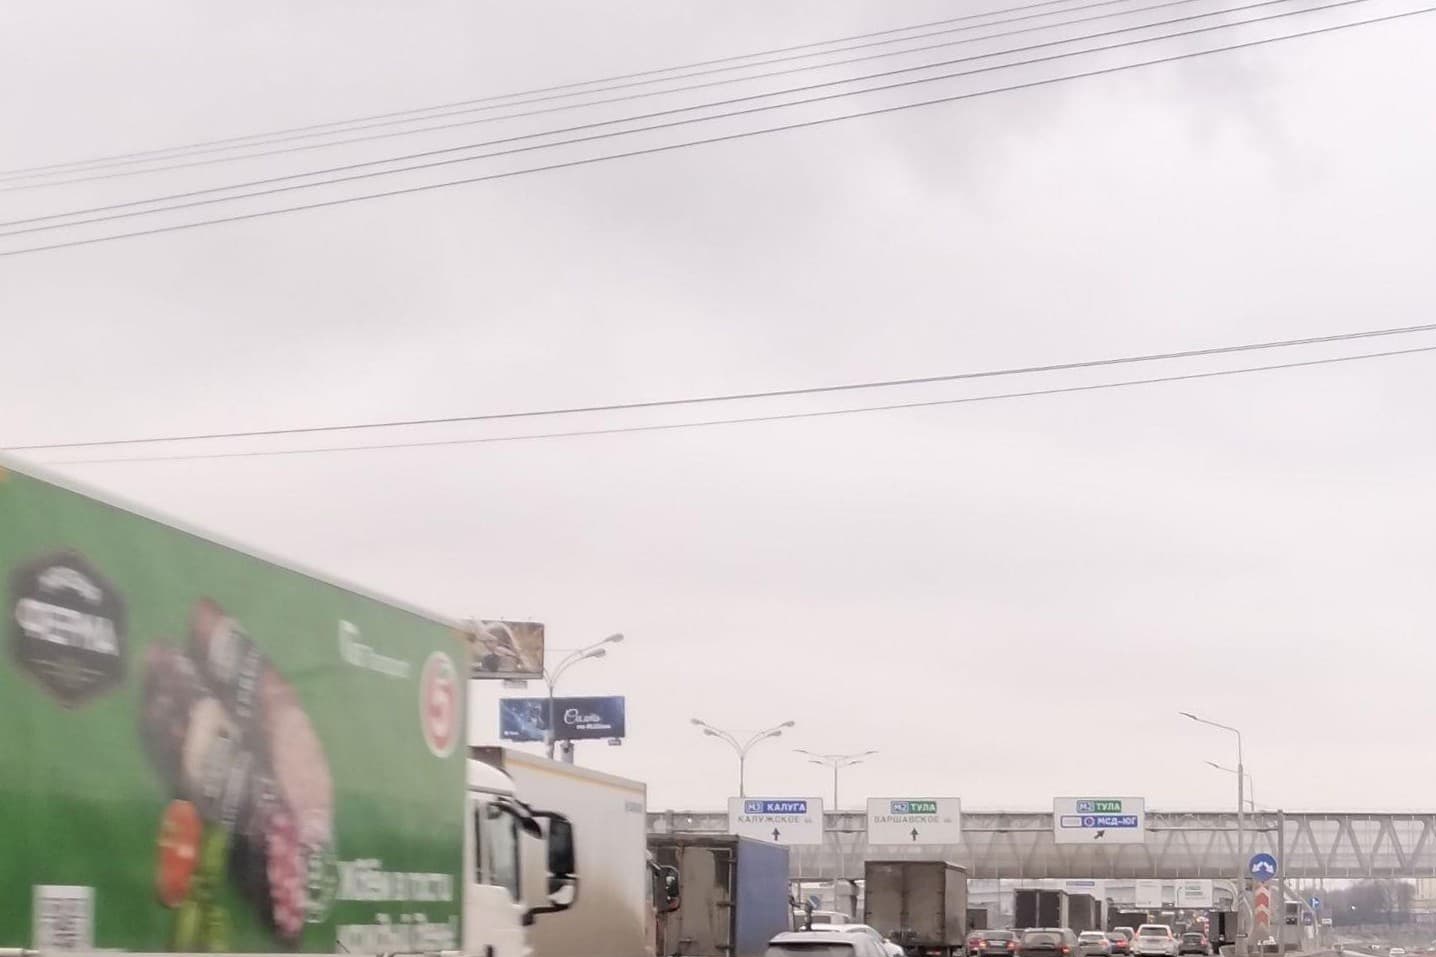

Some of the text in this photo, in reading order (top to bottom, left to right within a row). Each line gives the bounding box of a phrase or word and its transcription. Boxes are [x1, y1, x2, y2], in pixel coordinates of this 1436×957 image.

[766, 803, 806, 812] КАЛУГА
[910, 803, 936, 812] ТУЛА
[1096, 802, 1120, 811] ТУЛА
[737, 815, 800, 824] КАЛУЖСКОЕ
[874, 815, 939, 824] ВАРШАВСКОЕ
[1097, 817, 1136, 825] МСД-ЮГ
